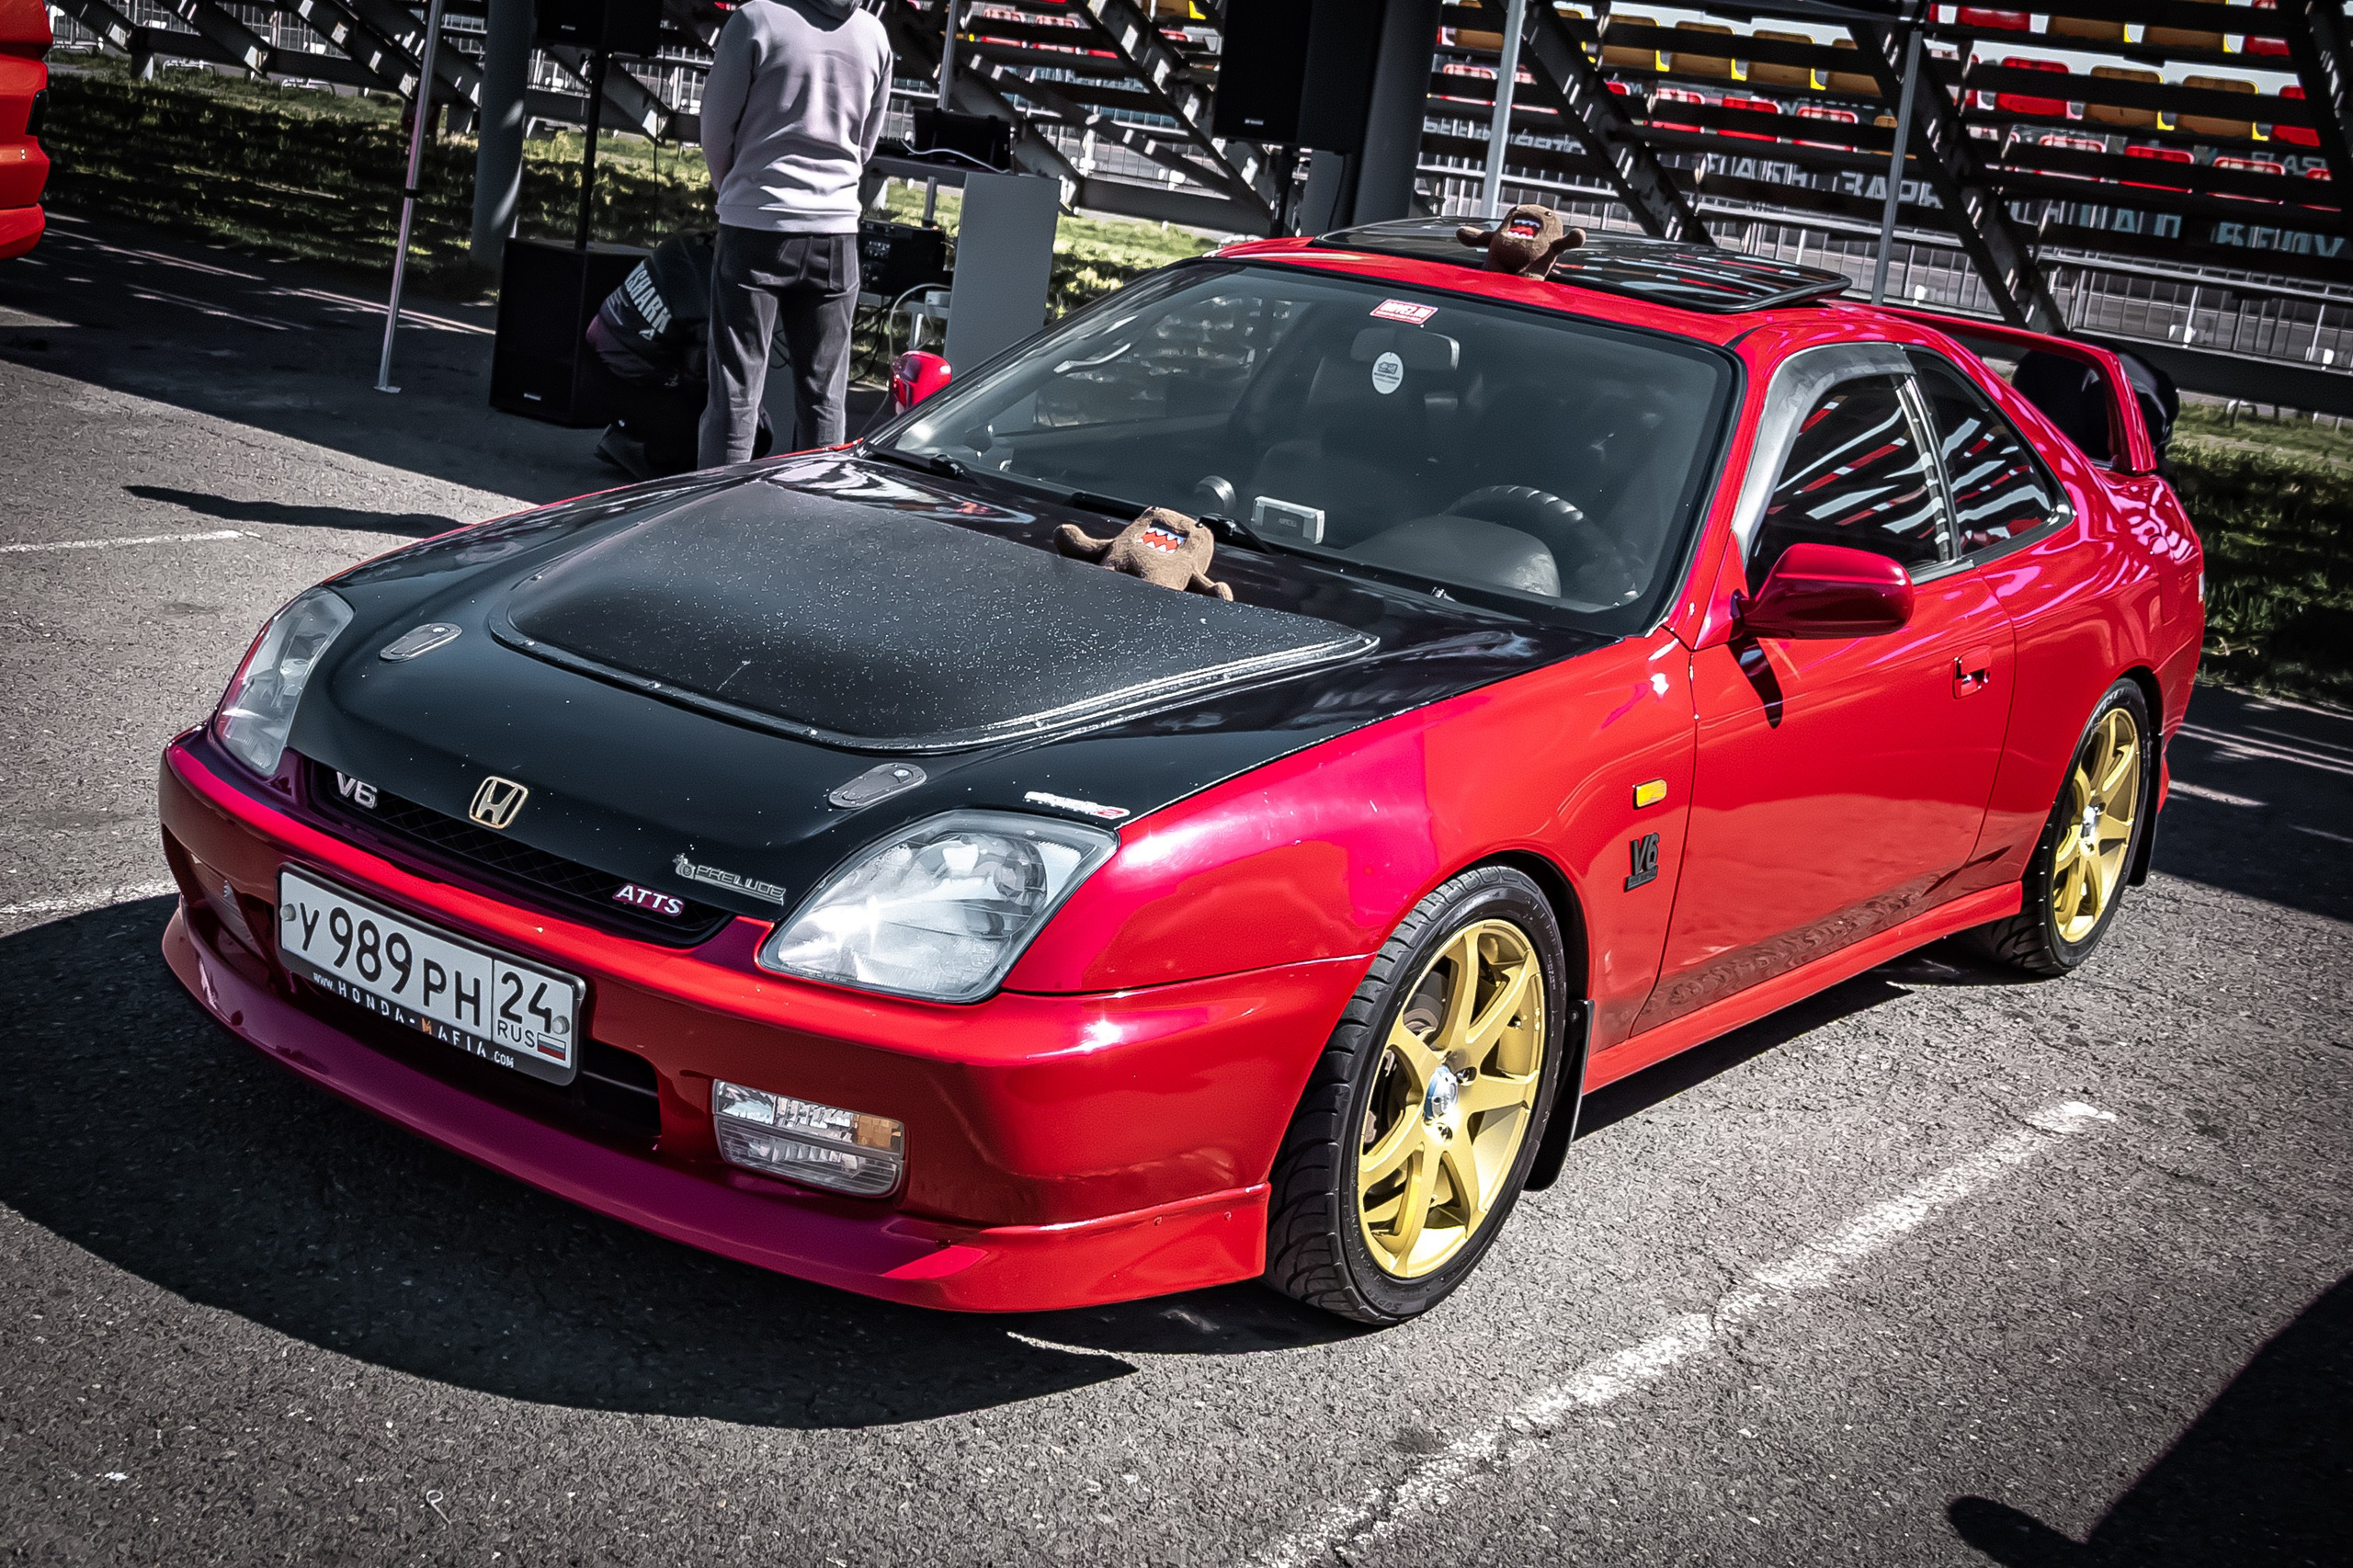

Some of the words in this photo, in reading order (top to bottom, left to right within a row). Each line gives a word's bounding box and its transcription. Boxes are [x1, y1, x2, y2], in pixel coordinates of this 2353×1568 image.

[336, 771, 378, 809] V6
[1630, 832, 1660, 877] V6
[615, 884, 684, 915] ATTS
[696, 864, 787, 899] PRELUDE
[499, 971, 552, 1034] 24
[497, 1018, 535, 1048] RUS
